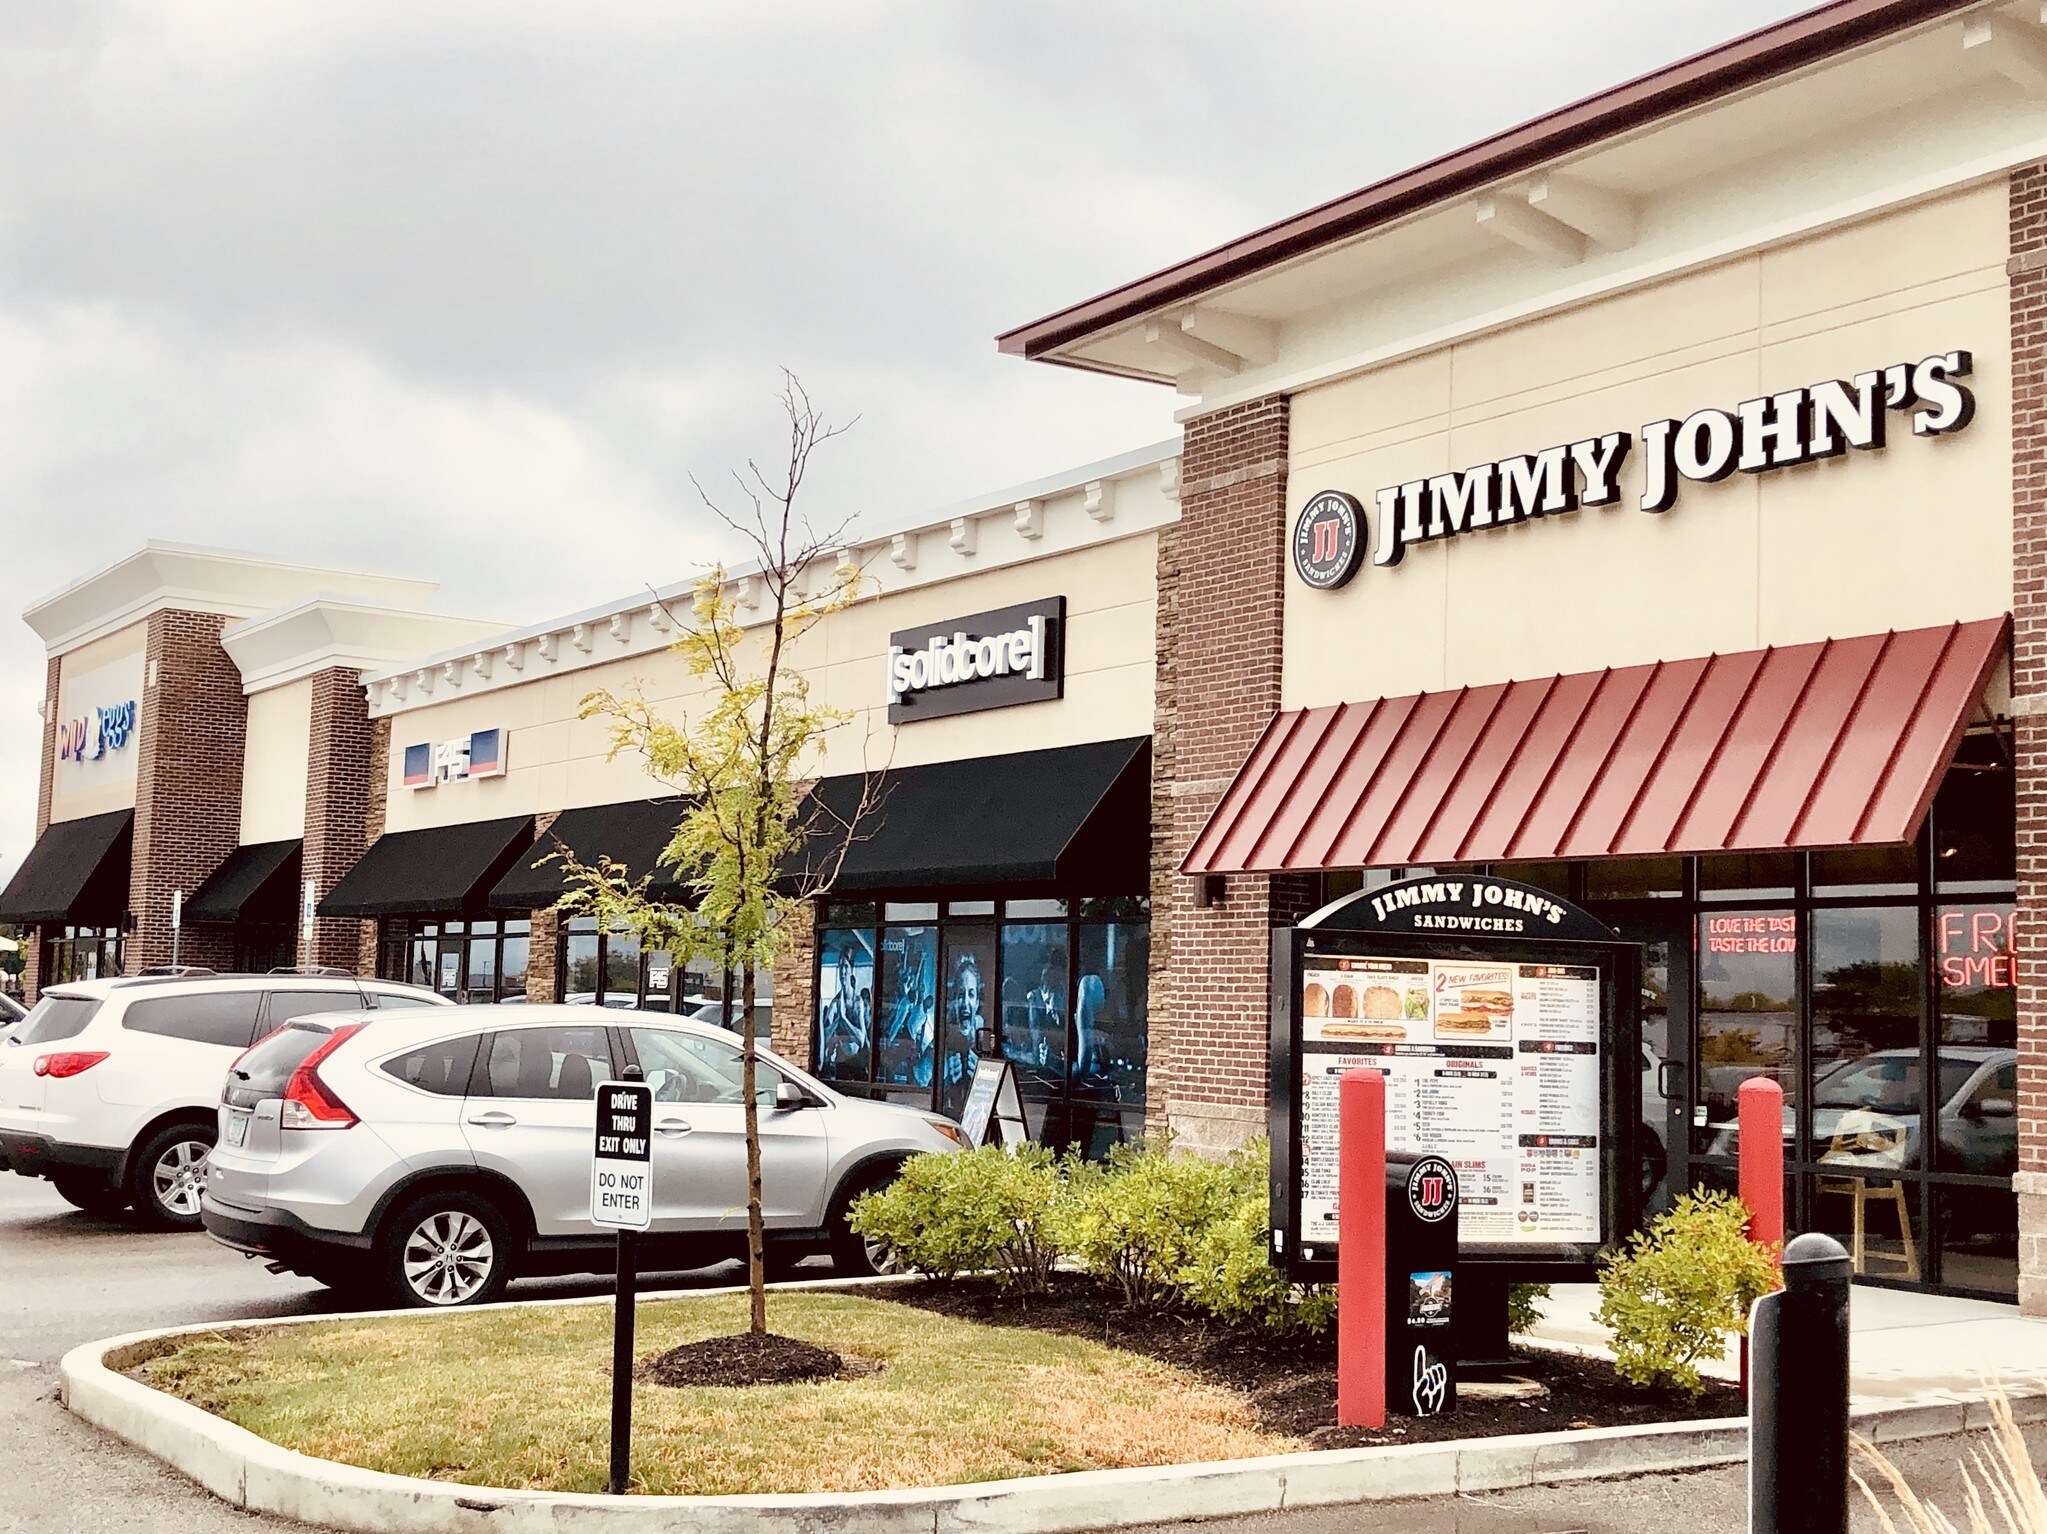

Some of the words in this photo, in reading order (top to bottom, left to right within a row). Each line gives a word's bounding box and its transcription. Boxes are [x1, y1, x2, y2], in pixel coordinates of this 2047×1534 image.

[1374, 432, 1632, 566] JIMMY
[1640, 350, 1973, 514] JOHN'S
[1300, 501, 1325, 544] JIMMY
[1312, 518, 1340, 564] JJ
[1302, 551, 1348, 580] SANDWICHES
[1371, 883, 1464, 922] JIMMY
[1471, 883, 1566, 925] JOHN'S
[1414, 915, 1524, 932] SANDWICHES
[1709, 918, 1741, 933] LOVE
[1743, 917, 1765, 933] THE
[1767, 916, 1796, 932] TAST
[1708, 937, 1744, 953] TASTE
[1746, 937, 1769, 953] THE
[1770, 937, 1796, 953] LOV
[1942, 956, 2019, 987] SMEL
[1436, 973, 1447, 992] 2
[1449, 974, 1466, 984] NEW
[1338, 1057, 1377, 1065] FAVORITES
[1446, 1060, 1483, 1068] ORIGINALS
[611, 1093, 638, 1110] DRIVE
[612, 1115, 636, 1132] THRU
[599, 1136, 620, 1152] EXIT
[623, 1137, 646, 1154] ONLY
[1450, 1161, 1462, 1169] AIN
[1464, 1161, 1485, 1169] SLIMS
[599, 1173, 616, 1187] DO
[620, 1175, 644, 1190] NOT
[1412, 1163, 1431, 1191] JIMMY
[1421, 1177, 1443, 1206] JJ
[602, 1193, 639, 1209] ENTER
